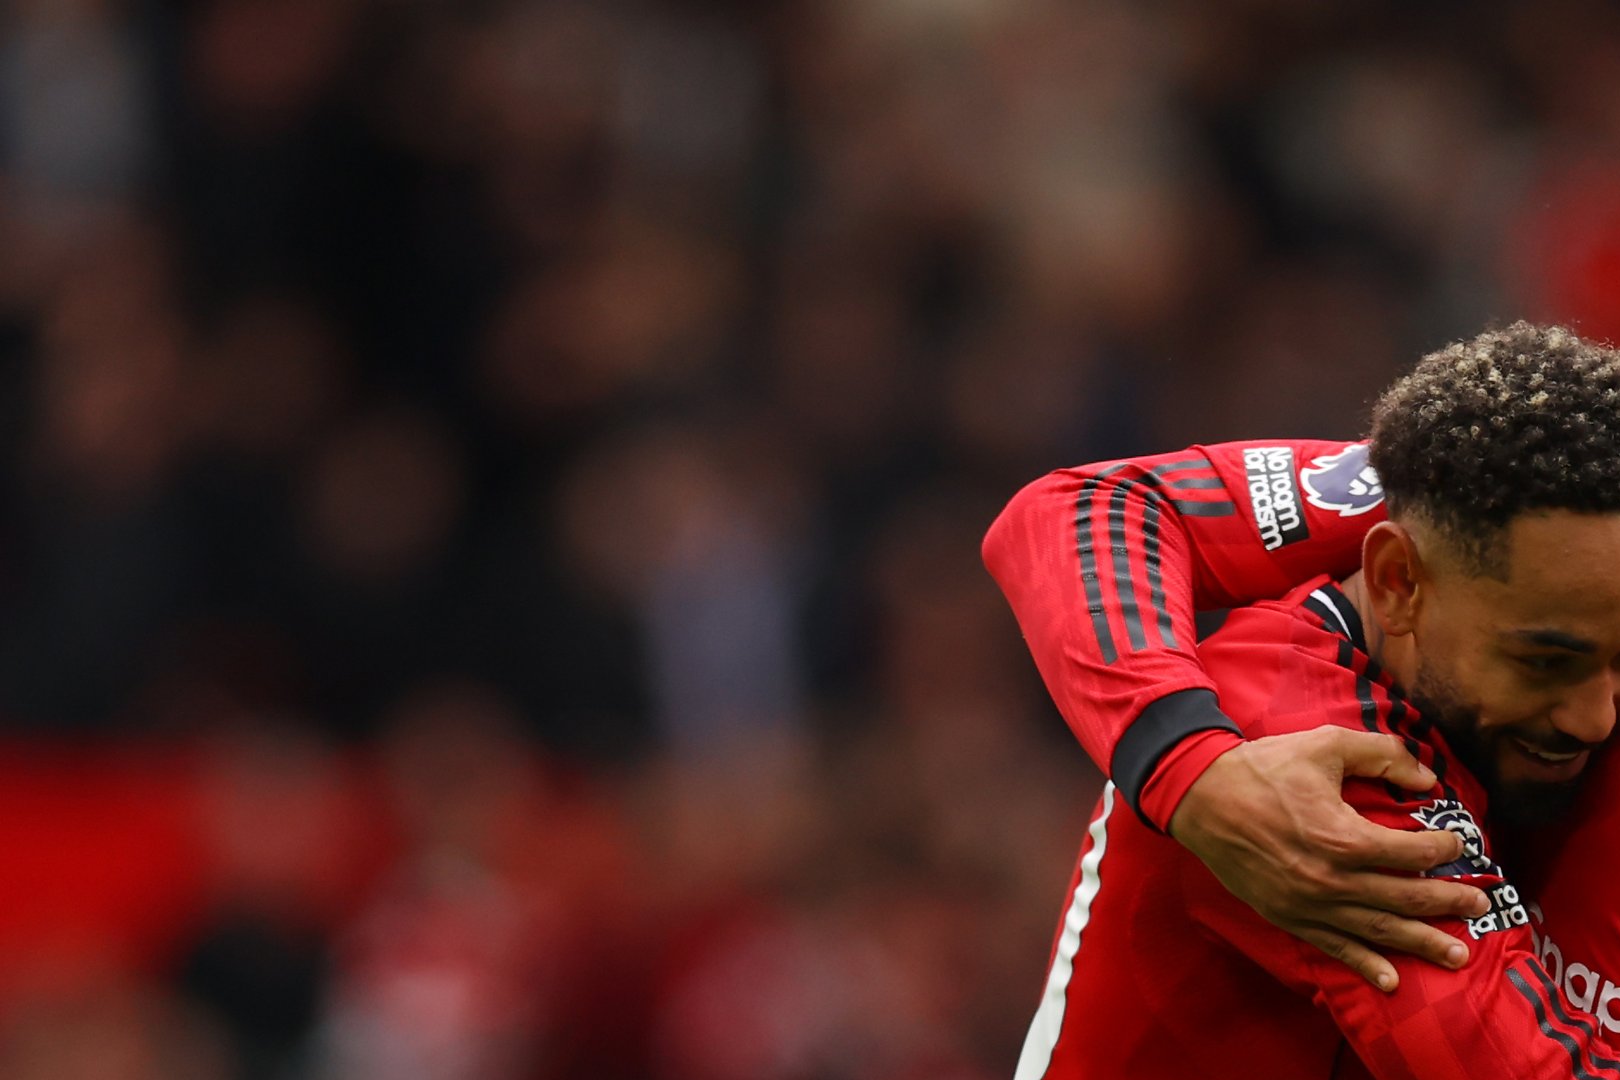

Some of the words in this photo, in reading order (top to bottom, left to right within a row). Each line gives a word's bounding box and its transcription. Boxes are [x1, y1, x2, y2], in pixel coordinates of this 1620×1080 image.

[1266, 447, 1292, 471] No
[1247, 474, 1283, 551] racism
[1269, 472, 1300, 531] room
